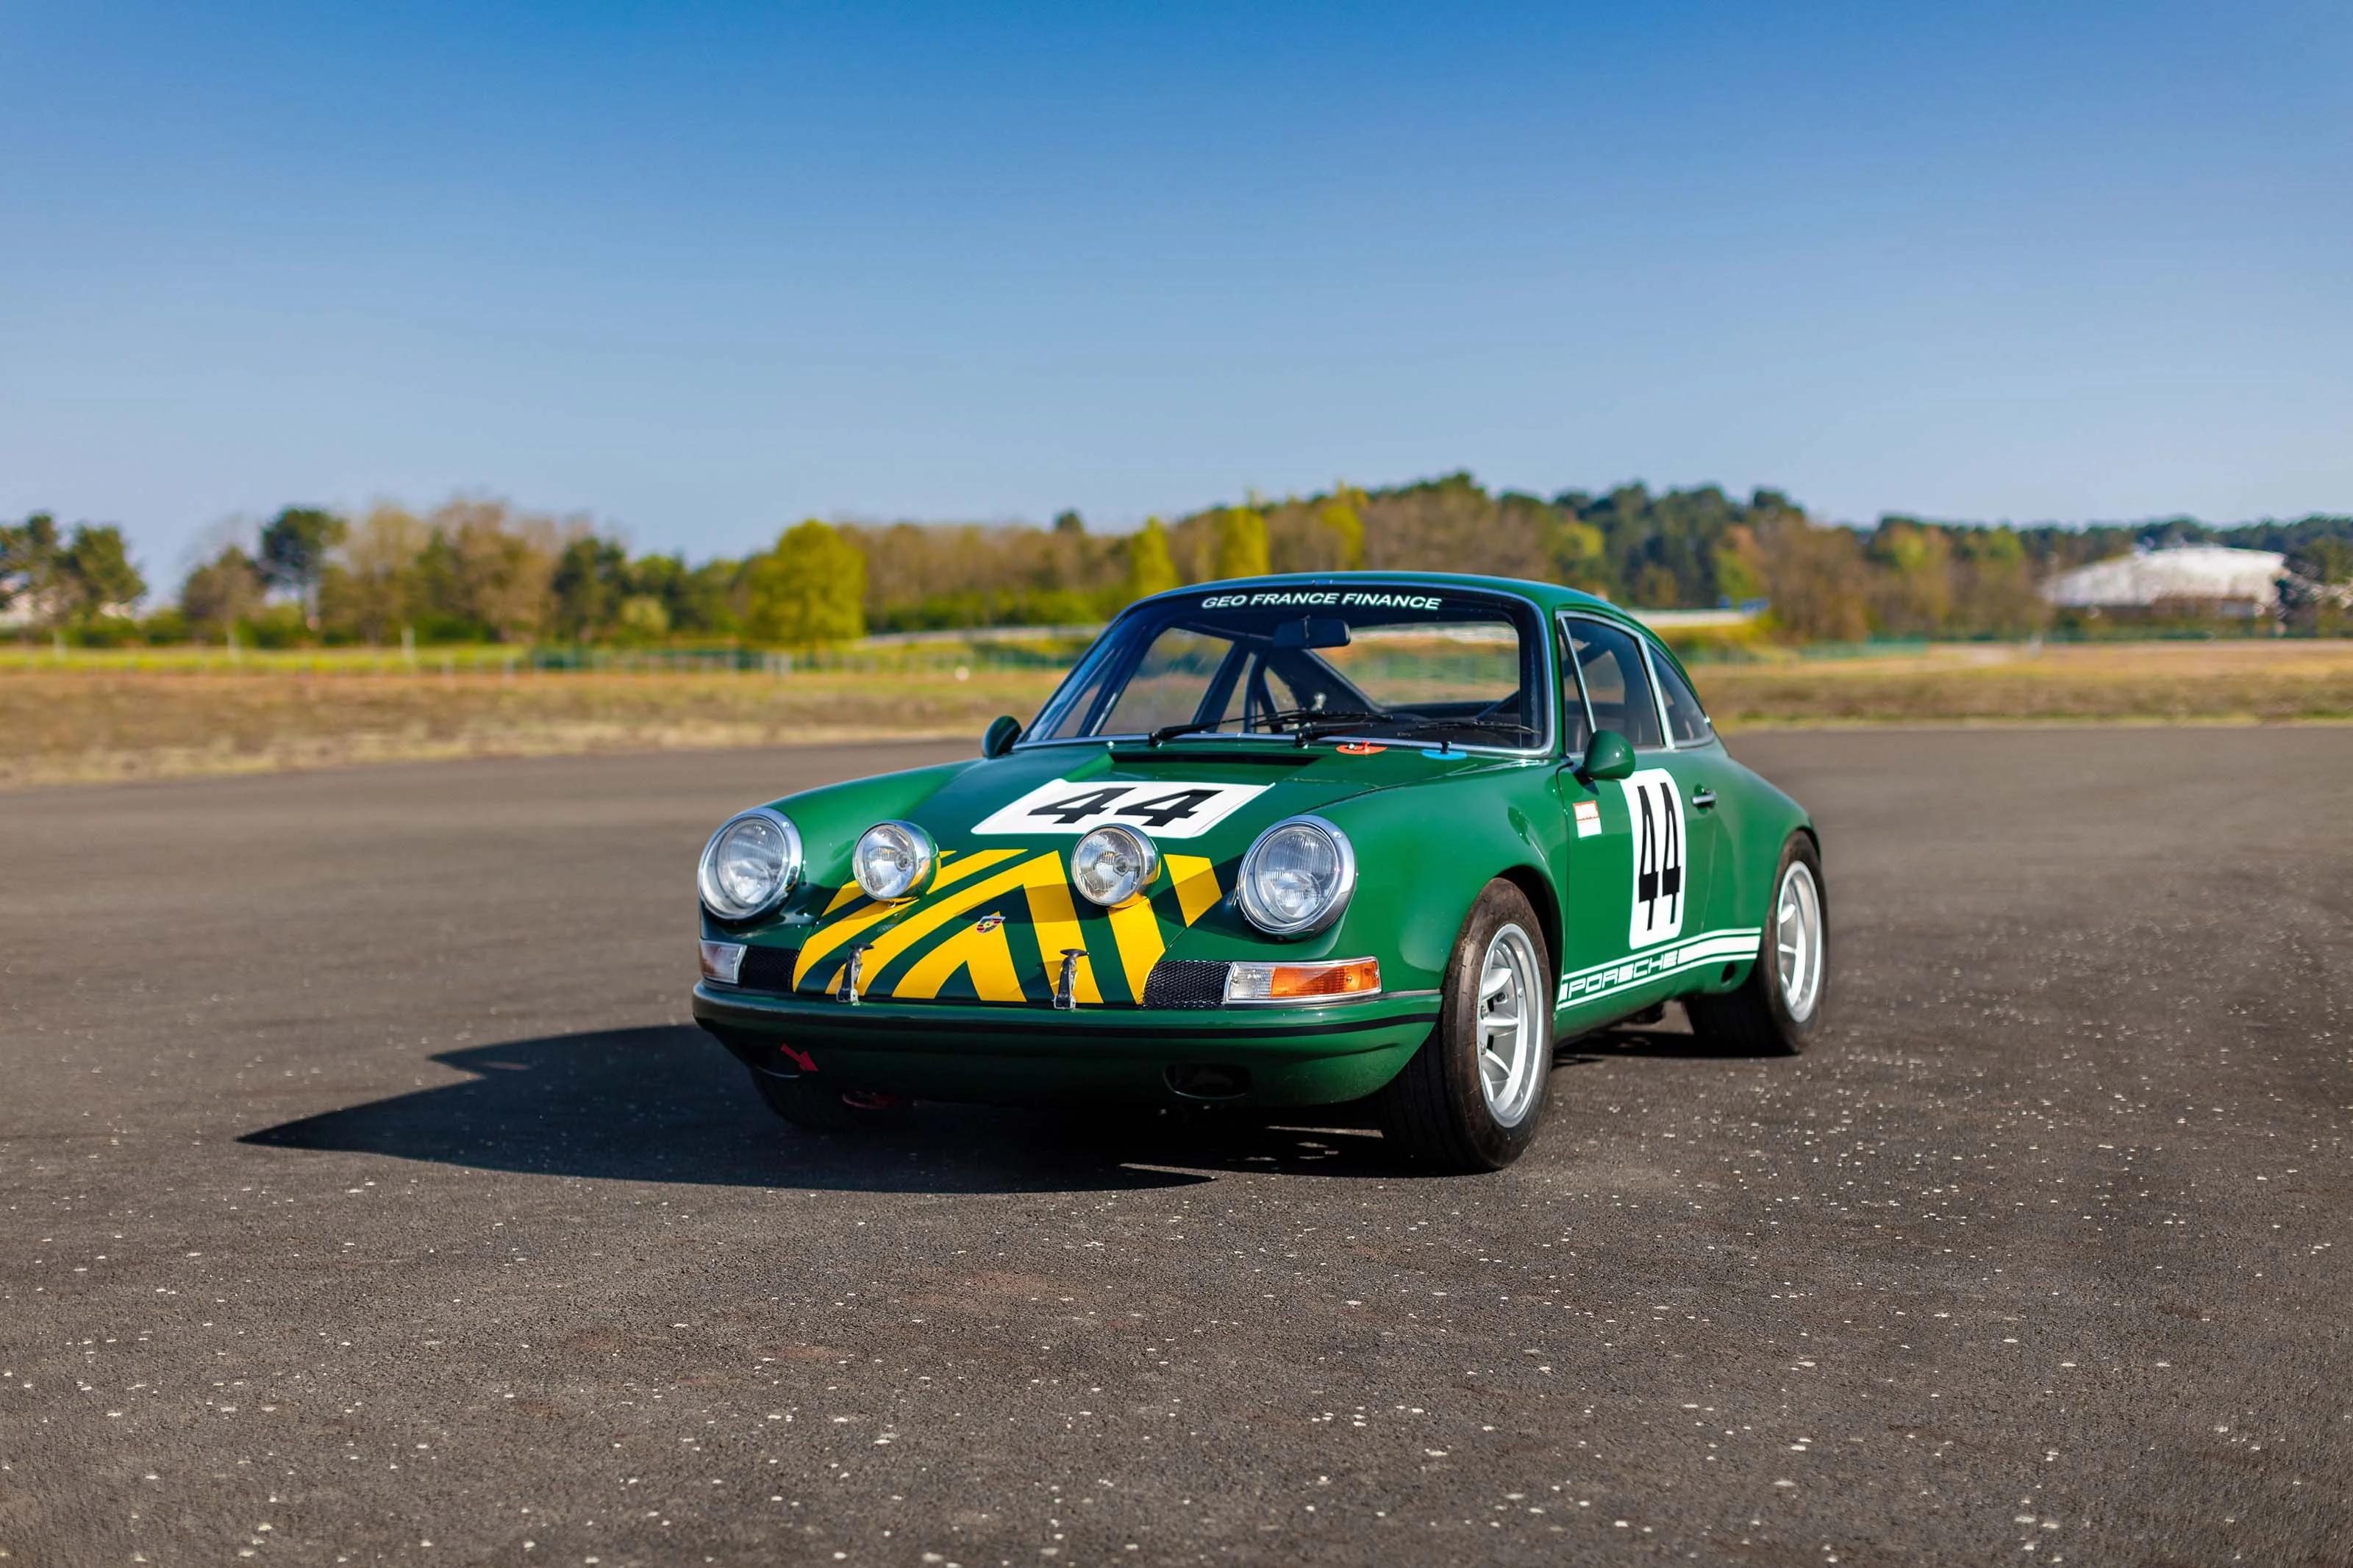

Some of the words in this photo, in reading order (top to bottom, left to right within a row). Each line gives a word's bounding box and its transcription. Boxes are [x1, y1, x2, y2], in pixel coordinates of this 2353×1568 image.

[1201, 594, 1247, 609] GEO
[1249, 593, 1340, 606] FRANCE
[1340, 593, 1443, 610] FINANCE
[1027, 787, 1224, 827] 44
[1638, 782, 1681, 931] 44
[1568, 949, 1679, 999] PORSCHE
